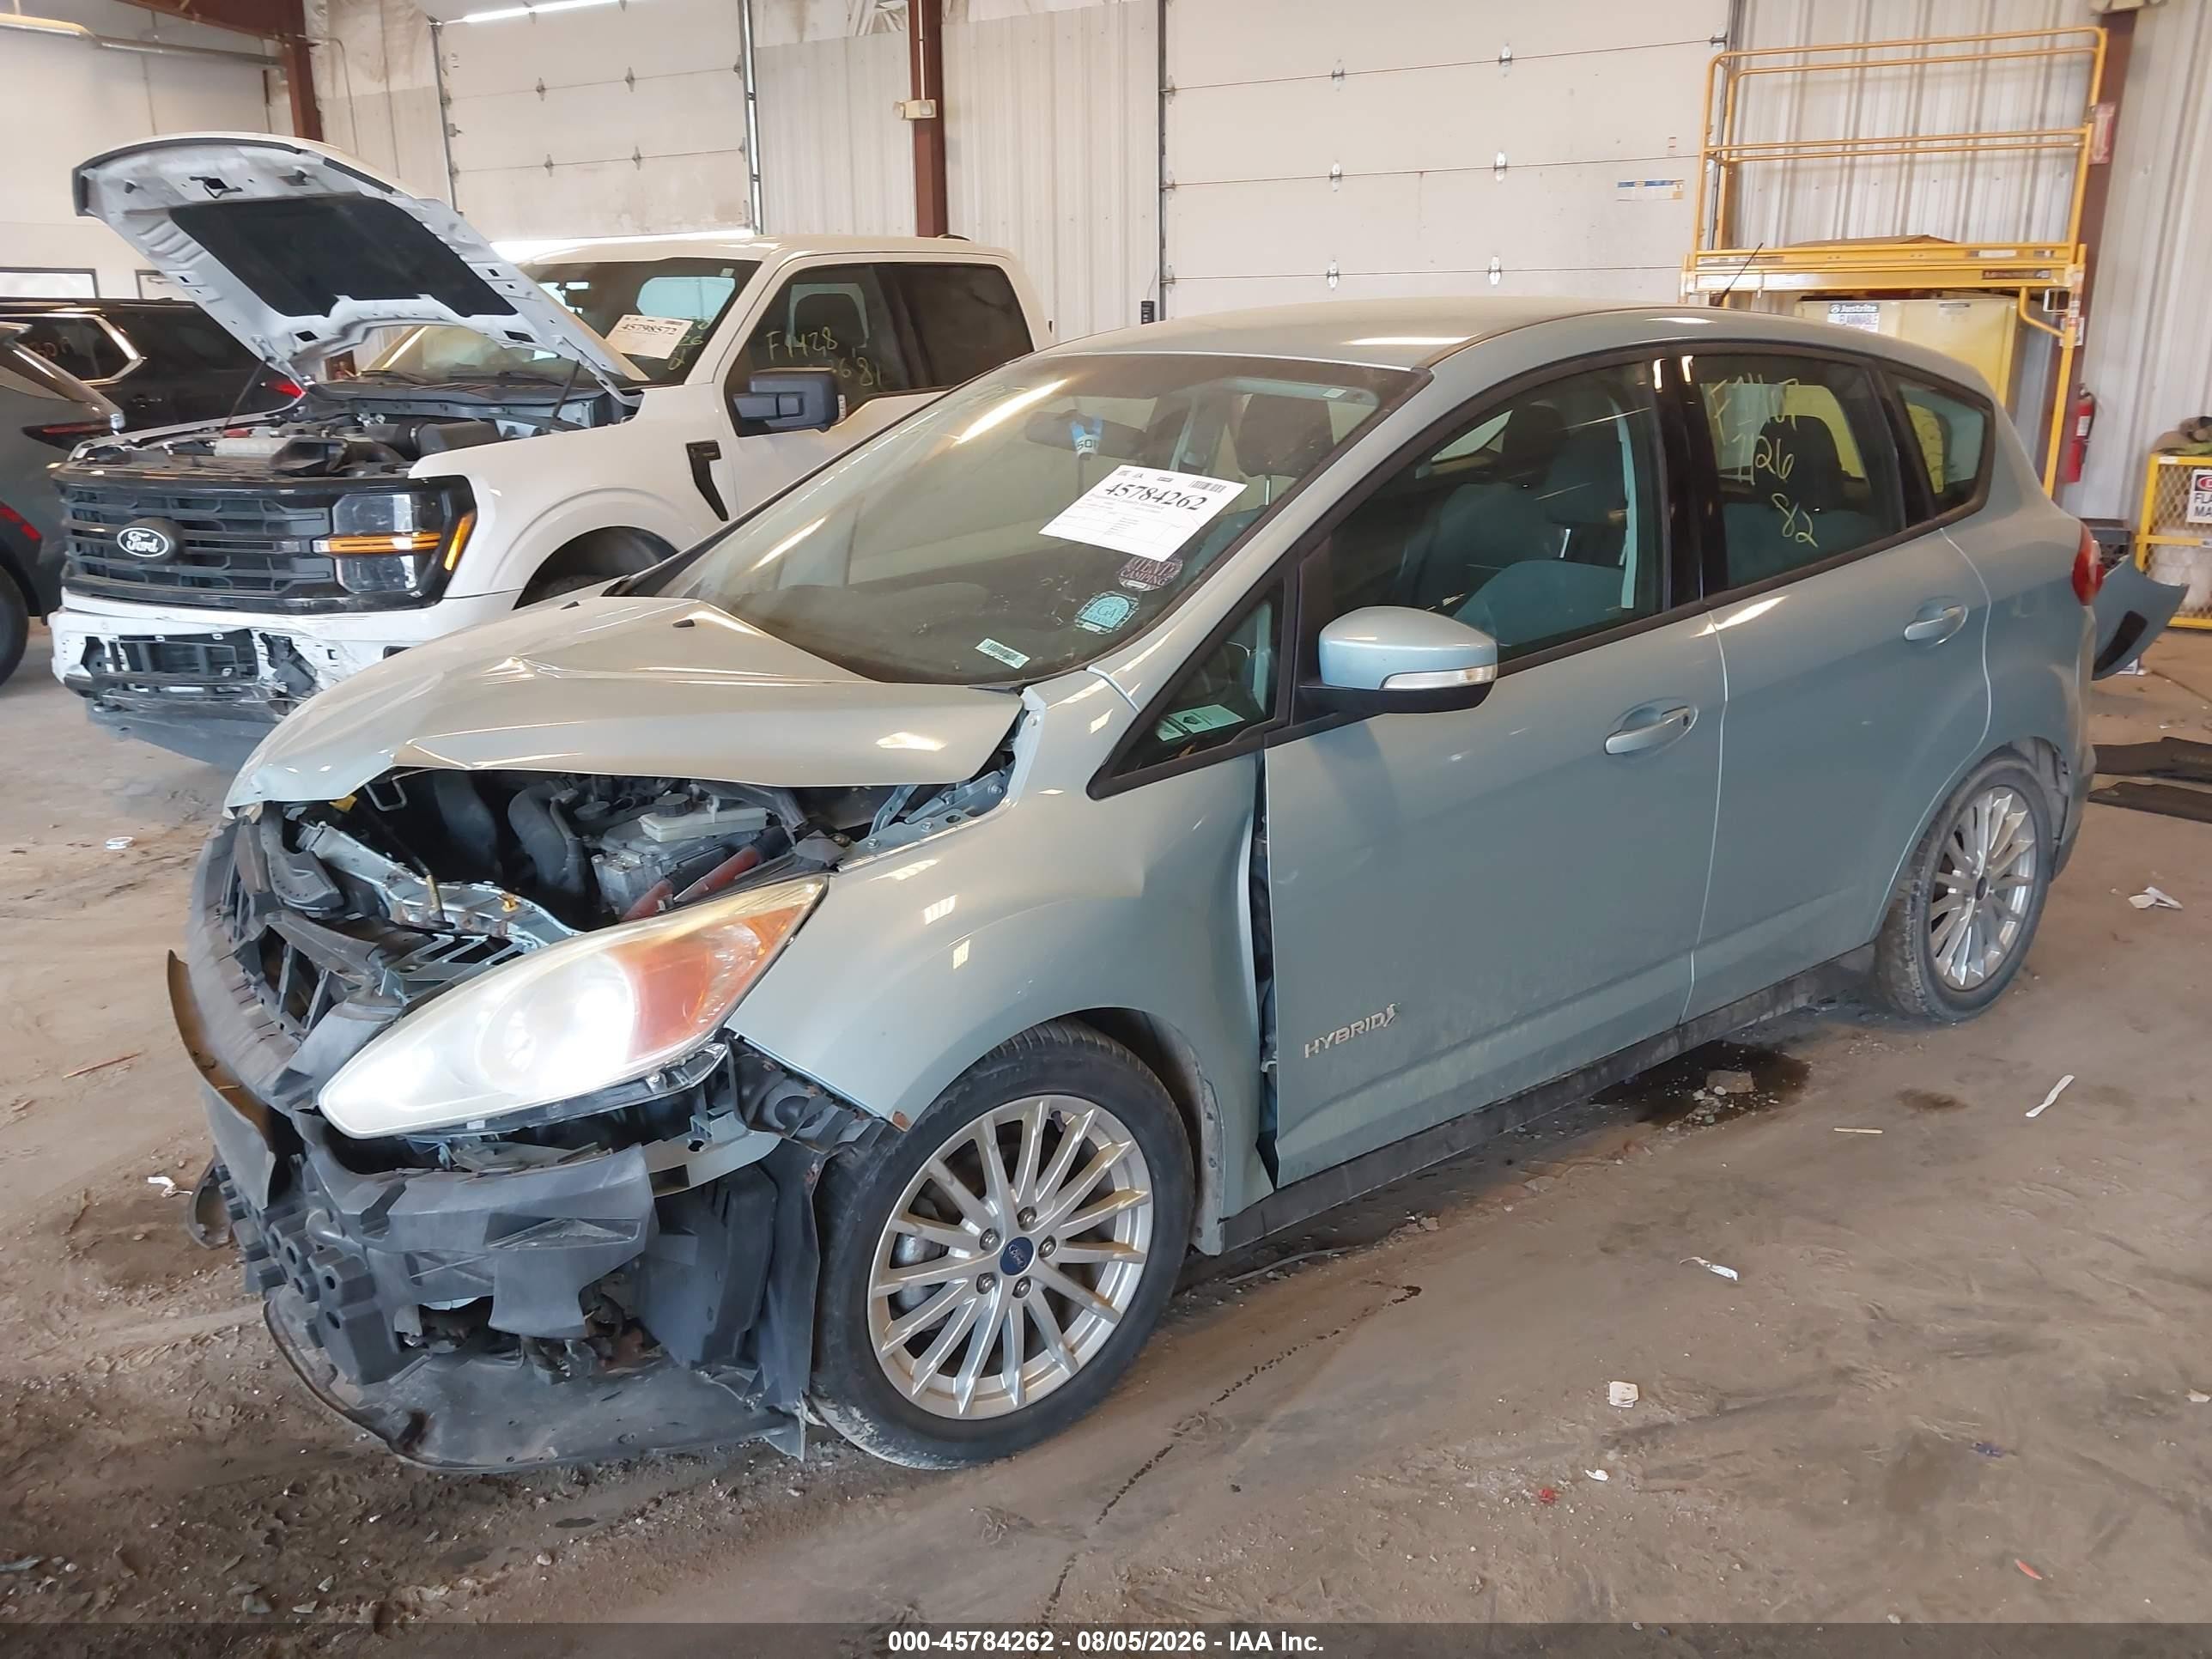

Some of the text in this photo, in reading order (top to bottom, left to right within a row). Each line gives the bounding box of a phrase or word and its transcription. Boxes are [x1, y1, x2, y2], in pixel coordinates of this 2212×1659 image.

[1105, 482, 1208, 511] 45784262
[125, 530, 160, 553] Ford
[1120, 569, 1170, 586] CAMPING
[1304, 1012, 1388, 1059] HYBRID
